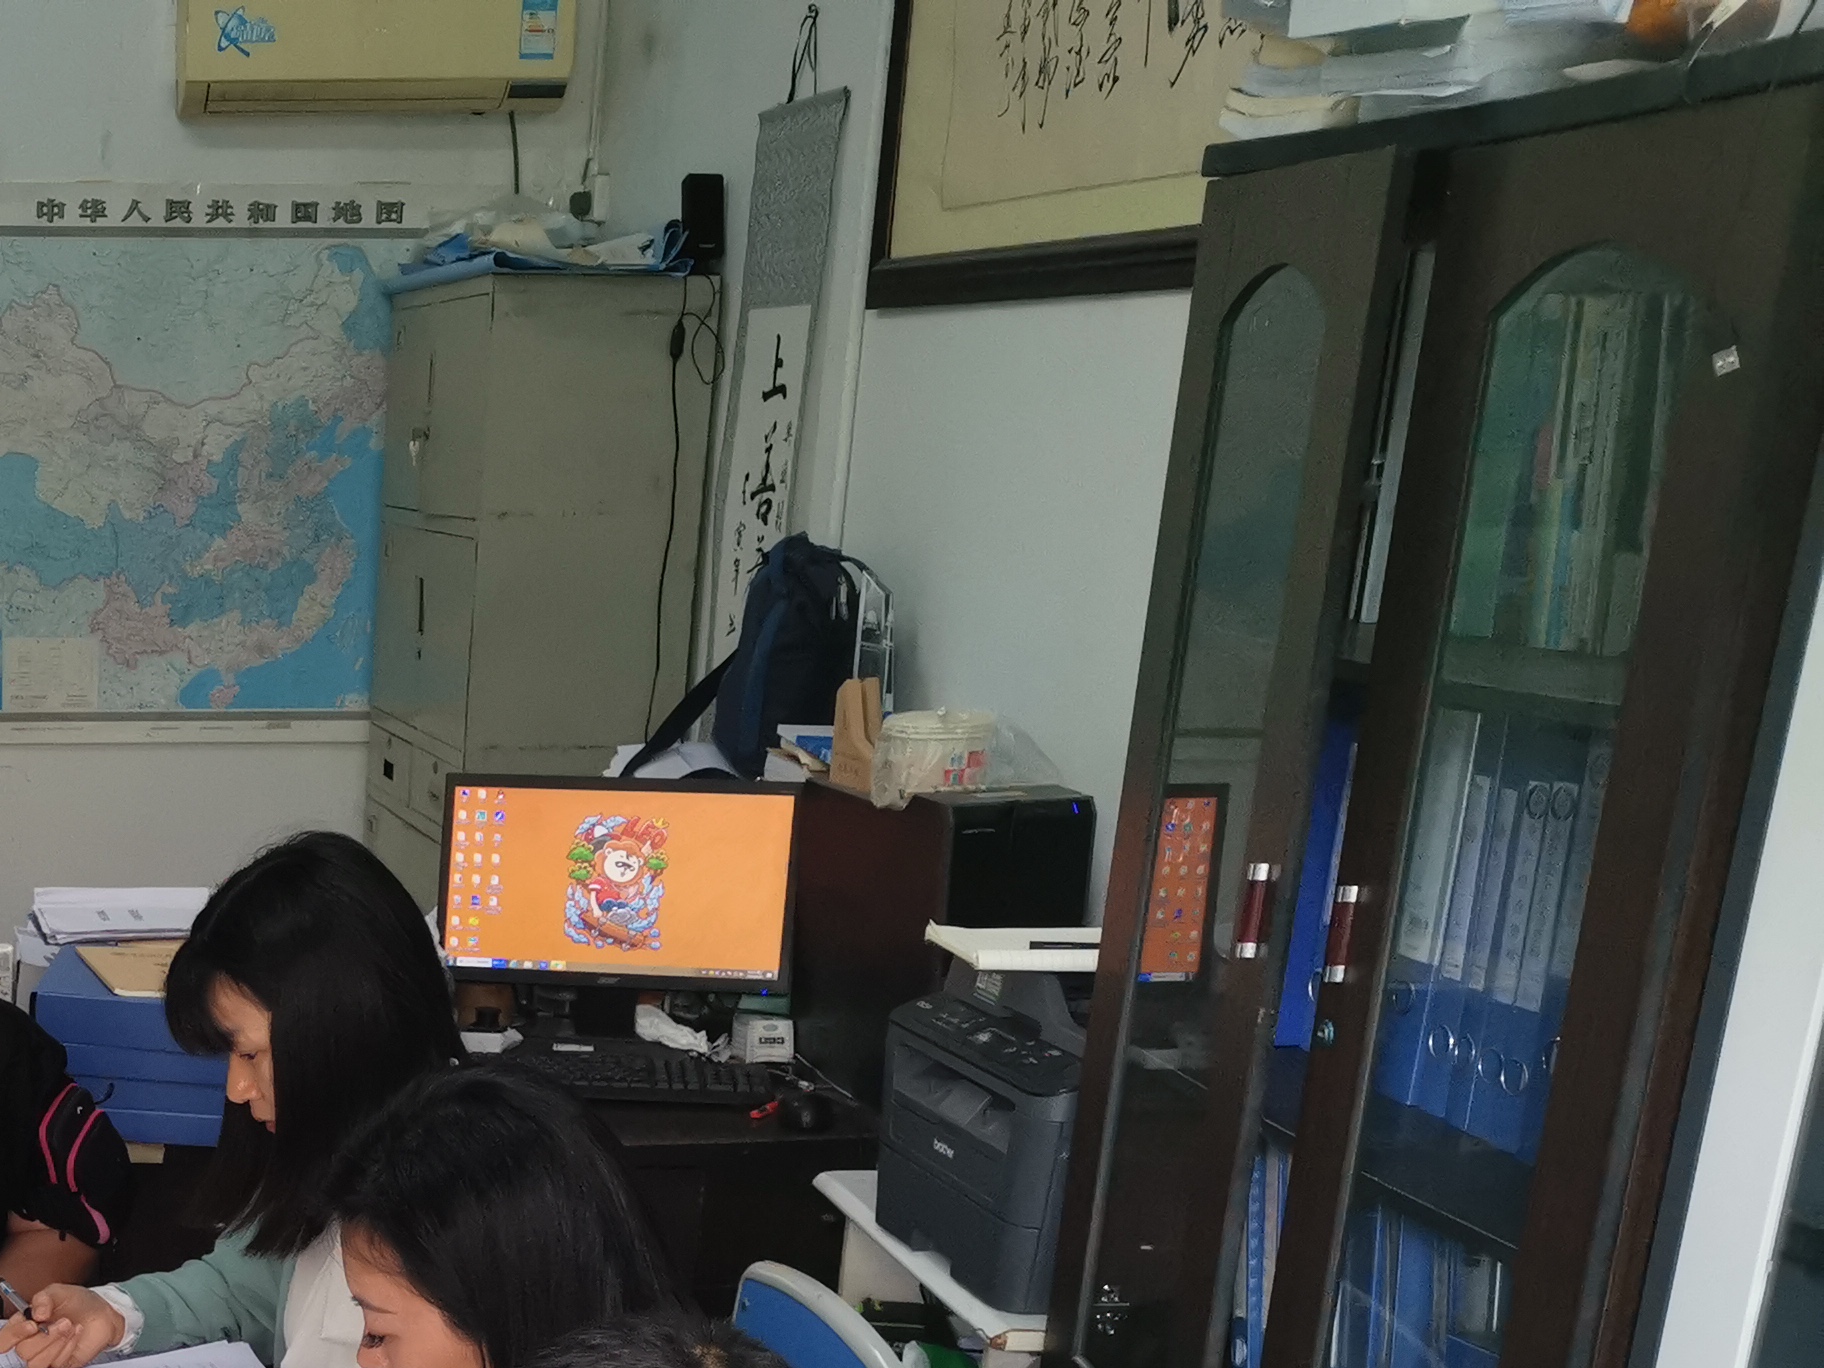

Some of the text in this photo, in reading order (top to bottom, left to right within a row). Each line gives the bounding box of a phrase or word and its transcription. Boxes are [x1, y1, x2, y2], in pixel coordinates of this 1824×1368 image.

[35, 198, 407, 225] 中华人民共和国地图
[620, 815, 669, 851] LEO
